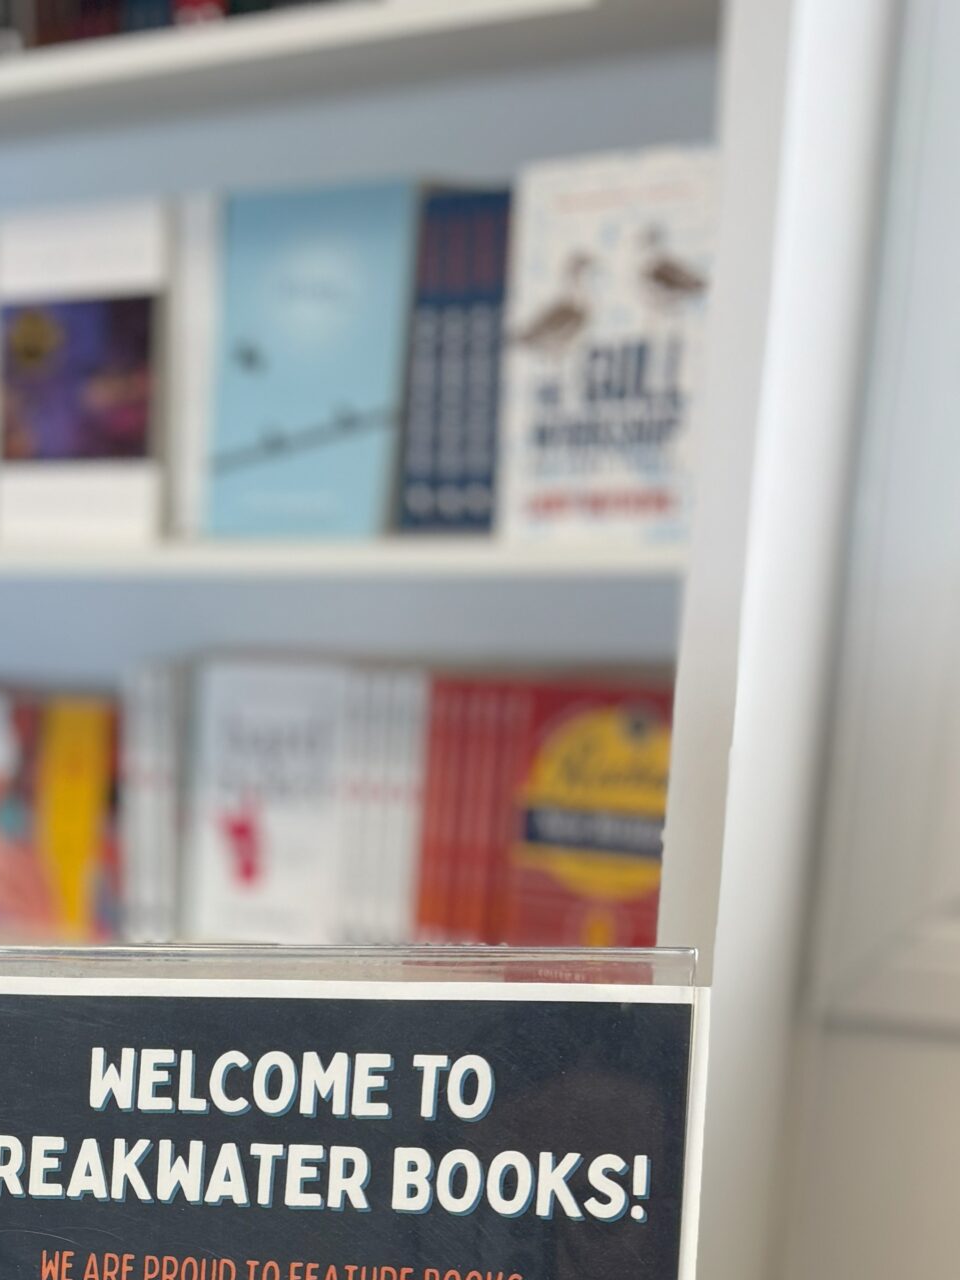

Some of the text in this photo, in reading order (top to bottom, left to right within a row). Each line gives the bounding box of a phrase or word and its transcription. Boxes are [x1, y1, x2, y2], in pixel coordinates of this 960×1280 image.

[89, 1046, 495, 1121] WELCOME TO
[391, 1146, 652, 1222] BOOKS!
